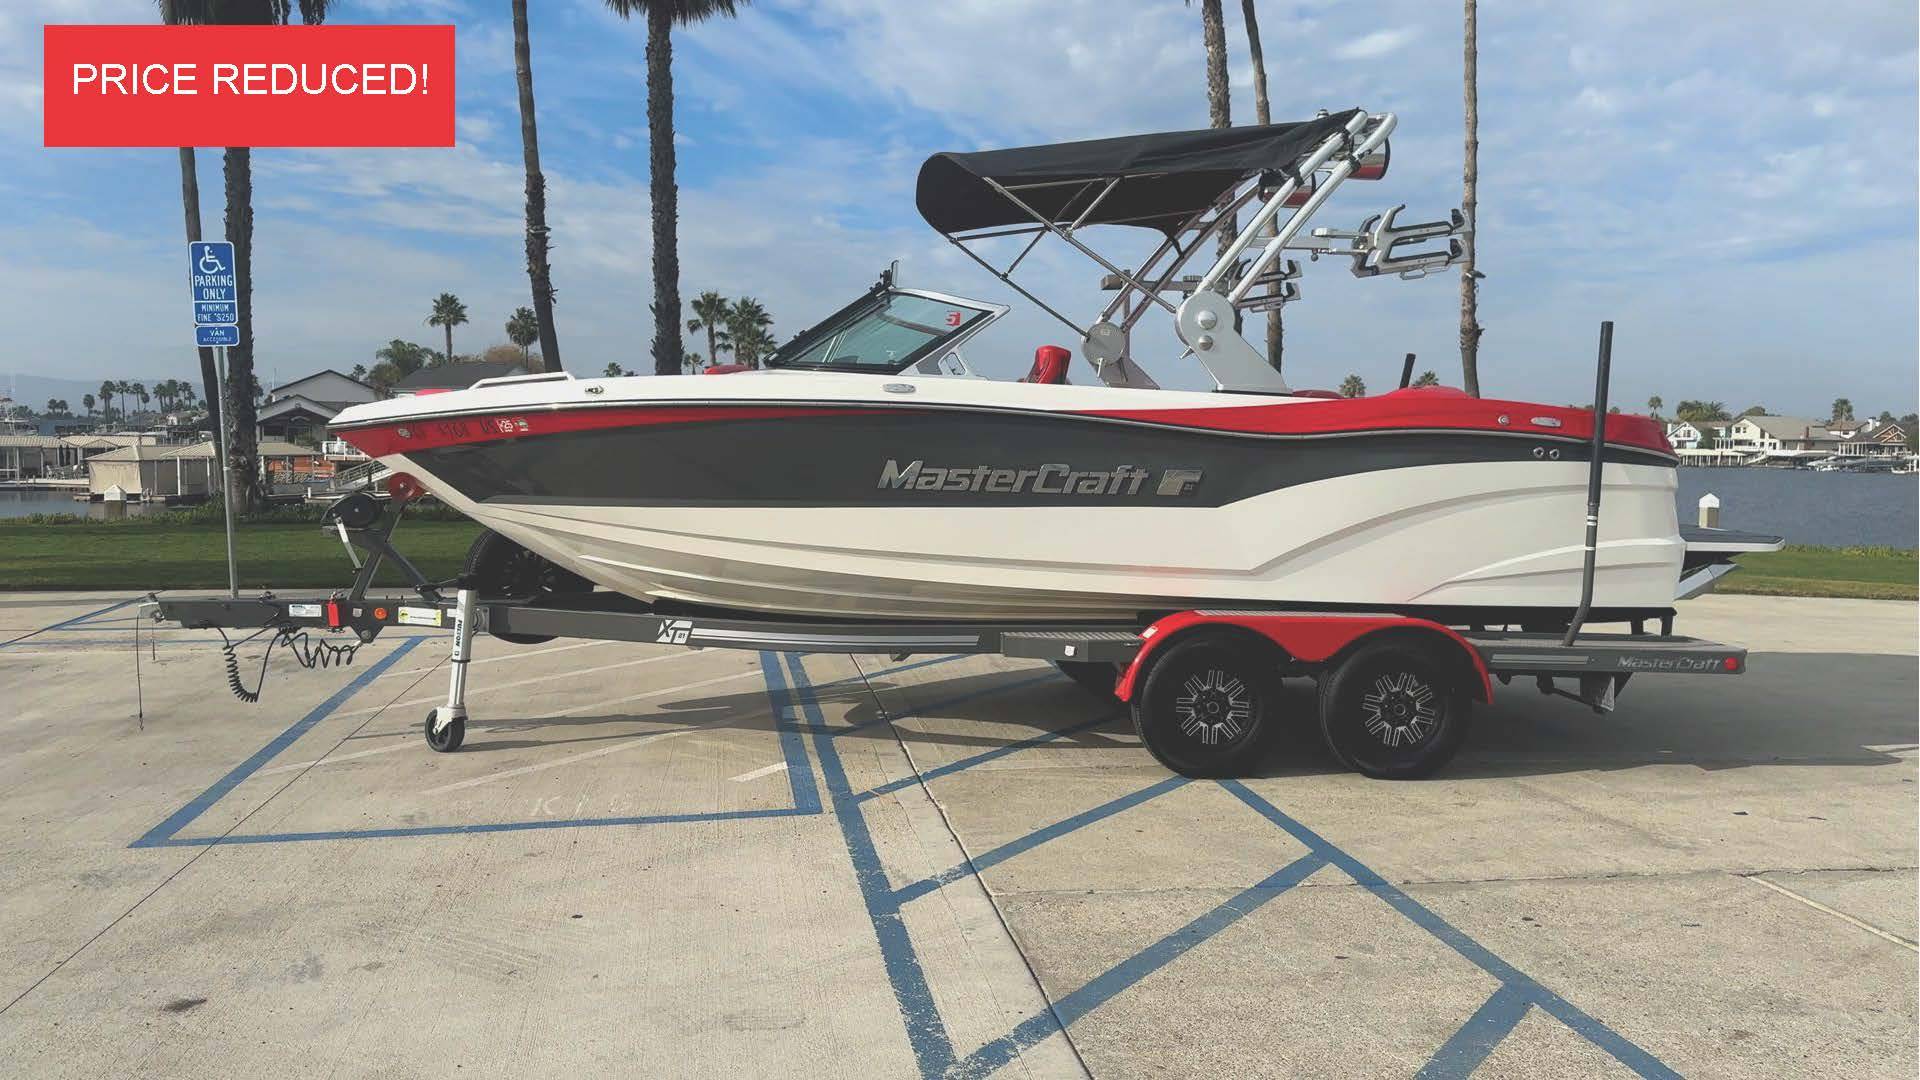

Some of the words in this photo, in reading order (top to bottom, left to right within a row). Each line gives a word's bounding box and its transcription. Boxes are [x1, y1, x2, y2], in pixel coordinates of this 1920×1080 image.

[194, 275, 233, 287] PARKING
[203, 288, 226, 300] ONLY
[201, 303, 229, 312] MINIMUM
[197, 313, 212, 322] FINE
[209, 329, 225, 337] VAN
[877, 459, 1149, 495] MasterCraft
[455, 619, 463, 648] FULTON
[656, 619, 692, 644] XT
[1617, 656, 1721, 671] MasterCraft
